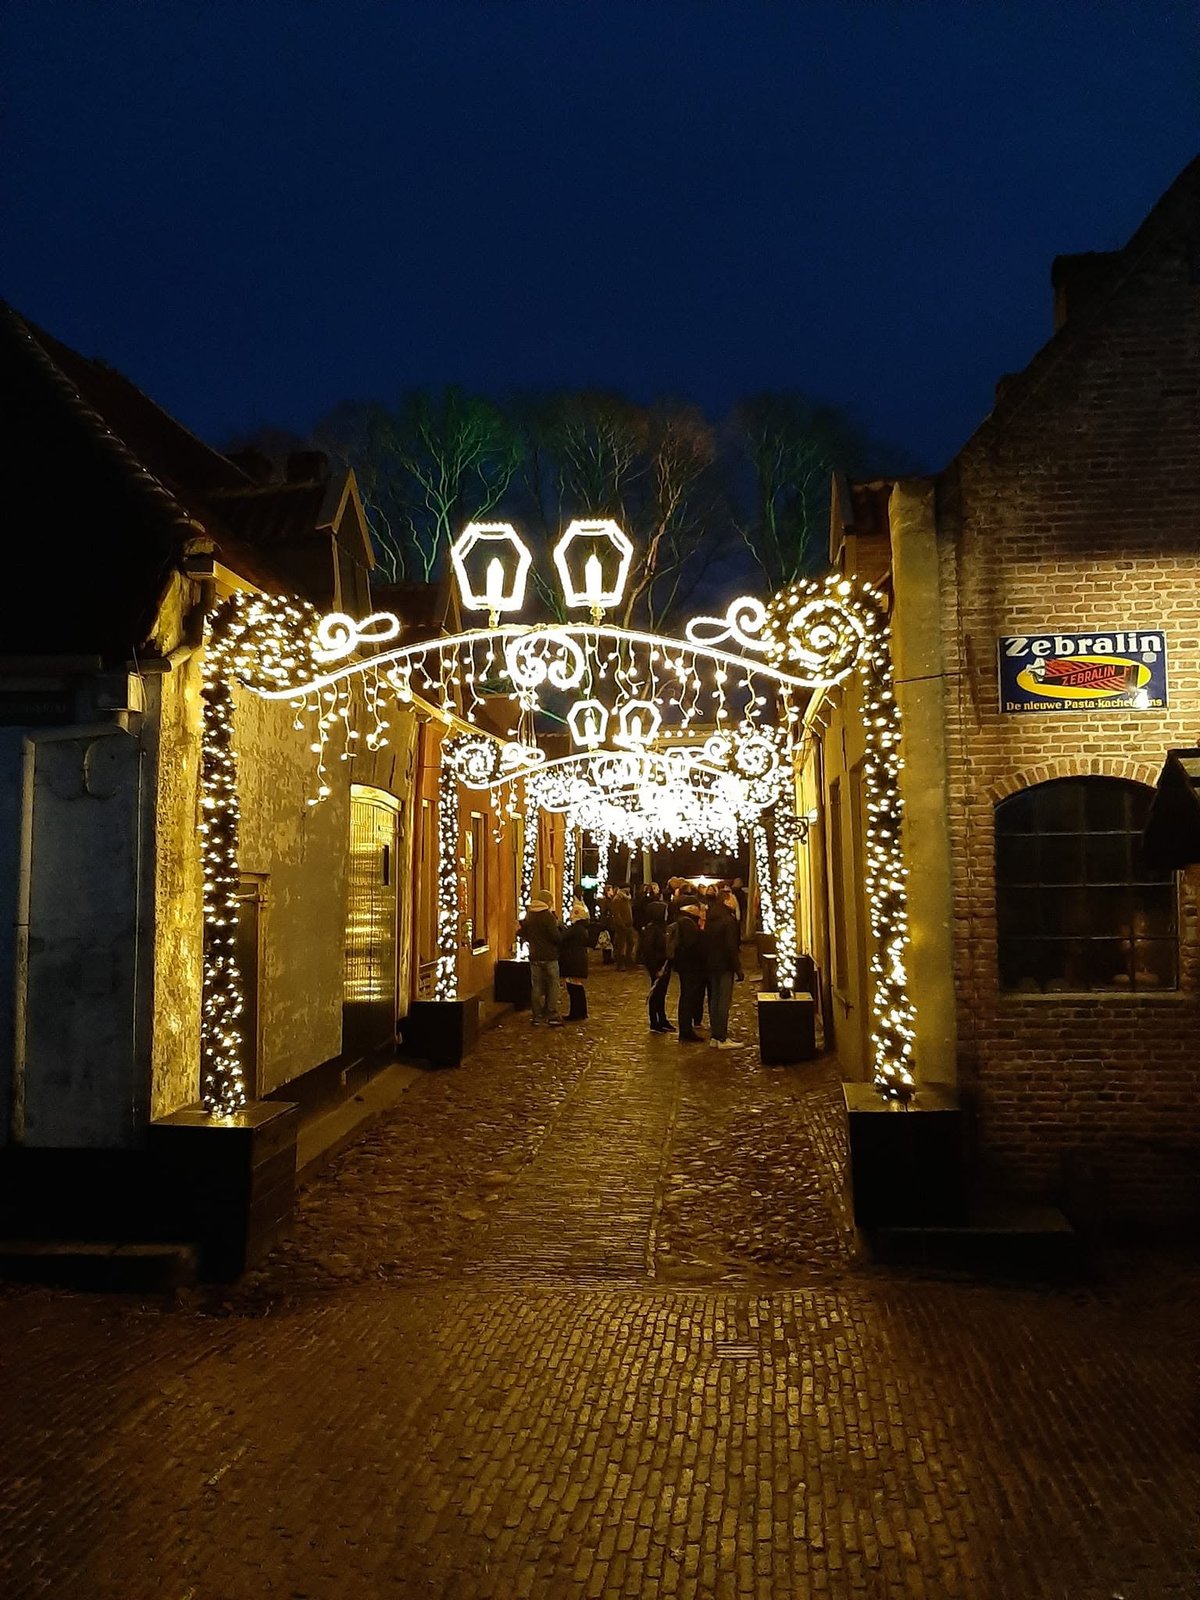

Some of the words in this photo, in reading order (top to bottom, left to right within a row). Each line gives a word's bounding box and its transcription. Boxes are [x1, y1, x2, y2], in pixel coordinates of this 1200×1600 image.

[1005, 633, 1161, 657] Zebralin
[1061, 665, 1116, 686] ZEBRALIN
[1006, 701, 1021, 711] De
[1023, 700, 1062, 710] nieuwe
